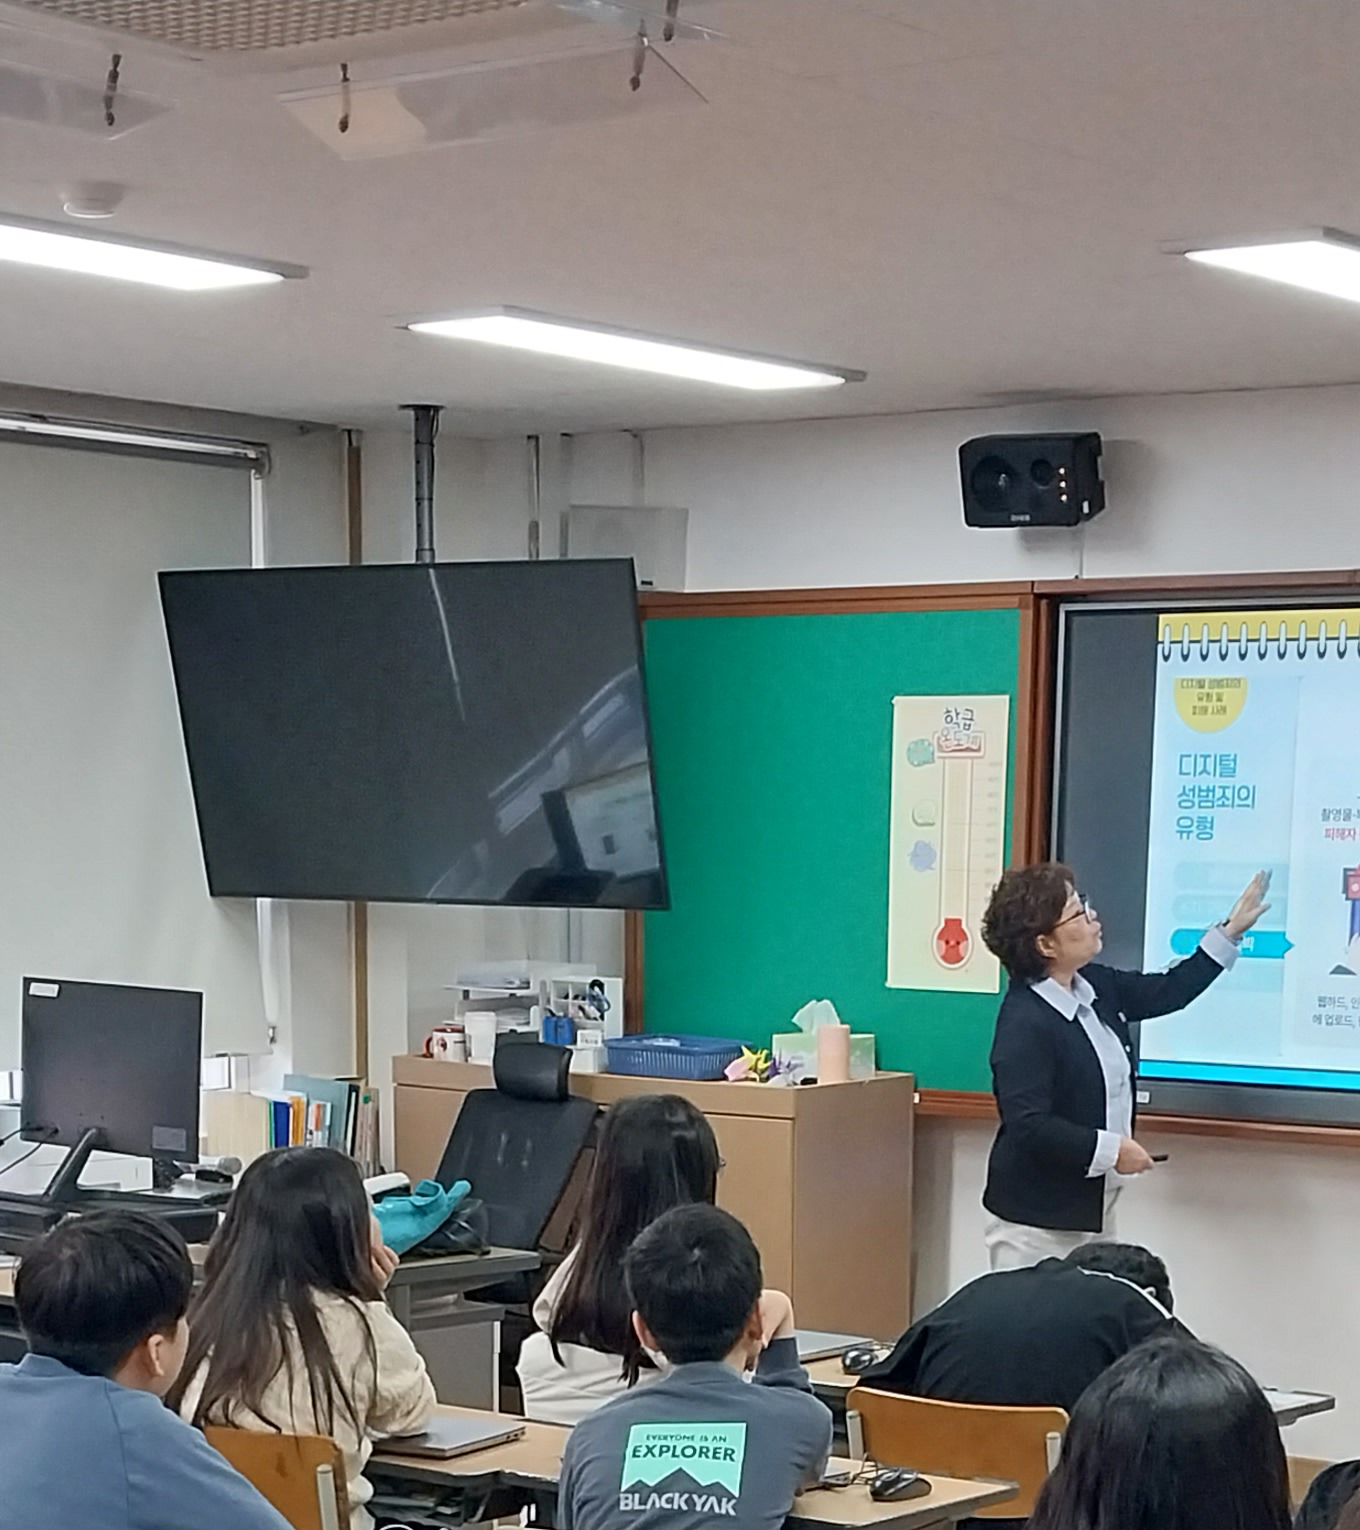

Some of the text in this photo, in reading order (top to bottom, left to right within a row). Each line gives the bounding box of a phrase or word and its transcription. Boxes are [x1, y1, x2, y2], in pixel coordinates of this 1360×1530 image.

[943, 706, 975, 731] 학급
[1178, 753, 1238, 778] 디지털
[1177, 784, 1256, 810] 성범죄의
[1175, 815, 1215, 841] 유형
[1324, 827, 1357, 841] 피해자
[711, 1435, 727, 1443] AN
[631, 1444, 736, 1463] EXPLORER
